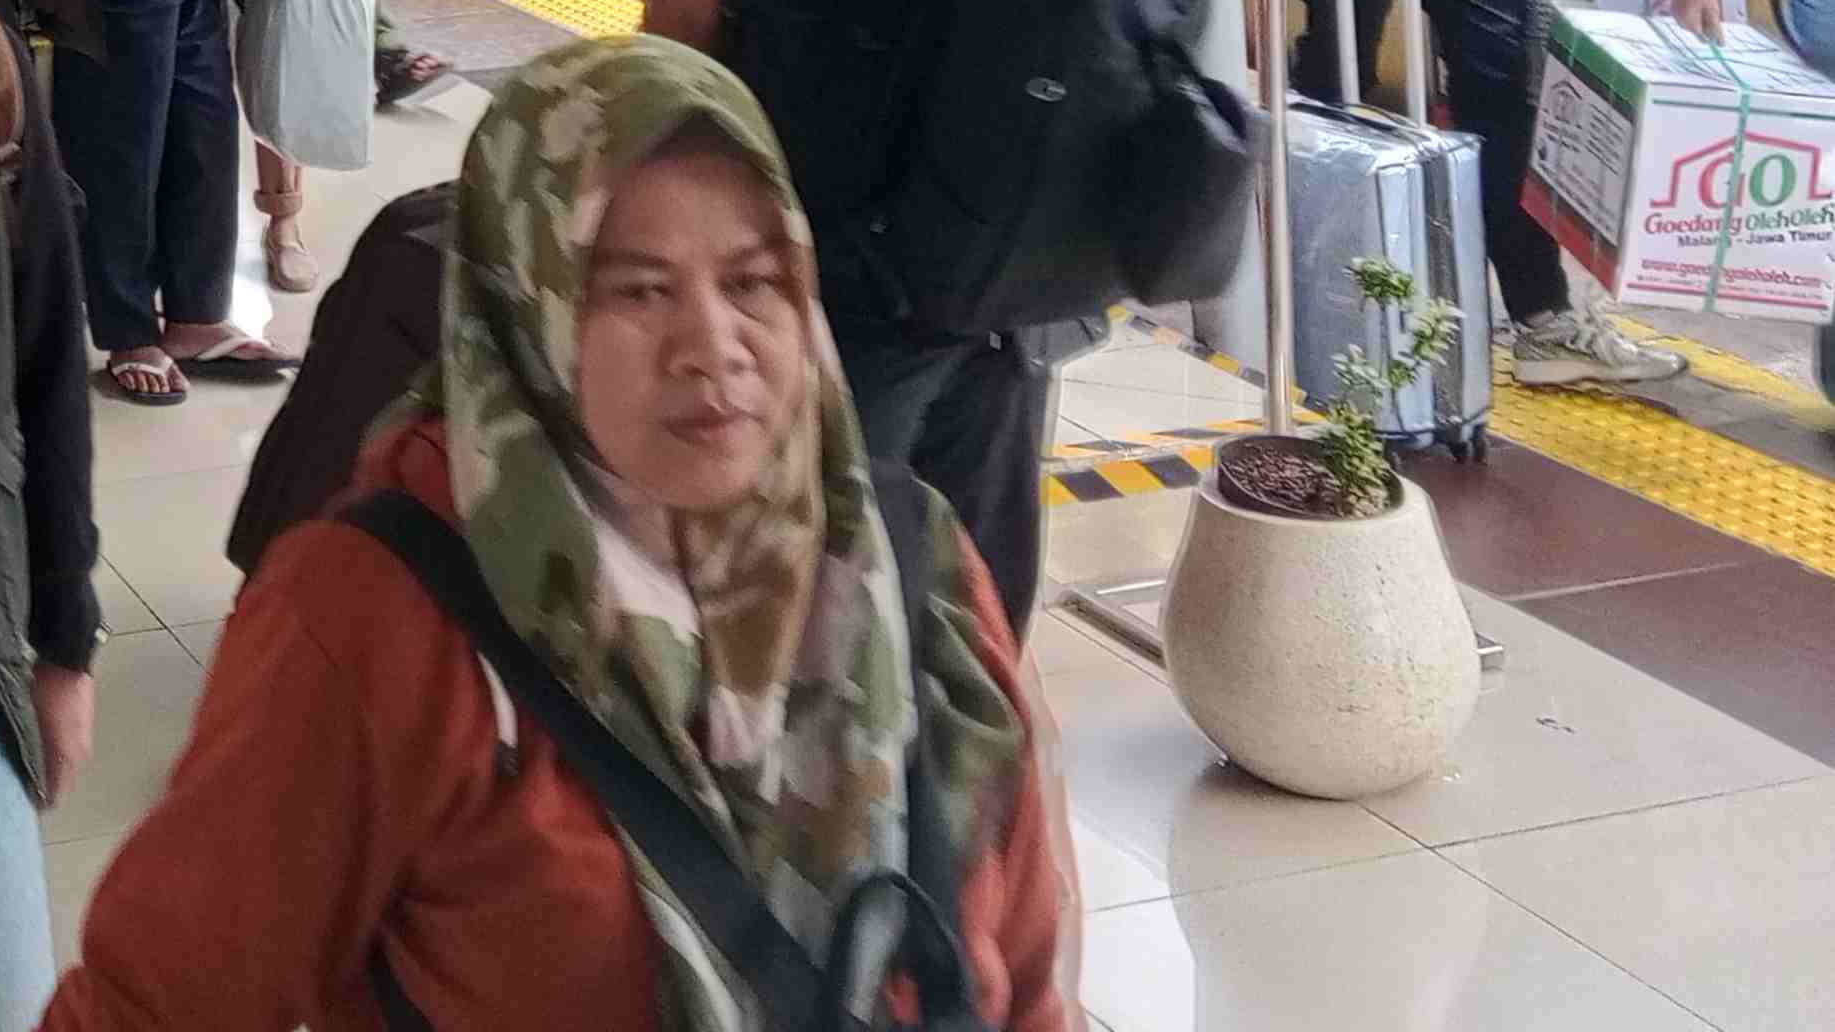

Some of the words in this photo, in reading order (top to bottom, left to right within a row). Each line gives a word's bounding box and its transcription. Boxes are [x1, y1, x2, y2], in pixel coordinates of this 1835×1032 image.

[1699, 152, 1797, 209] GO
[1746, 232, 1785, 245] Jawa
[1790, 230, 1833, 243] Timur
